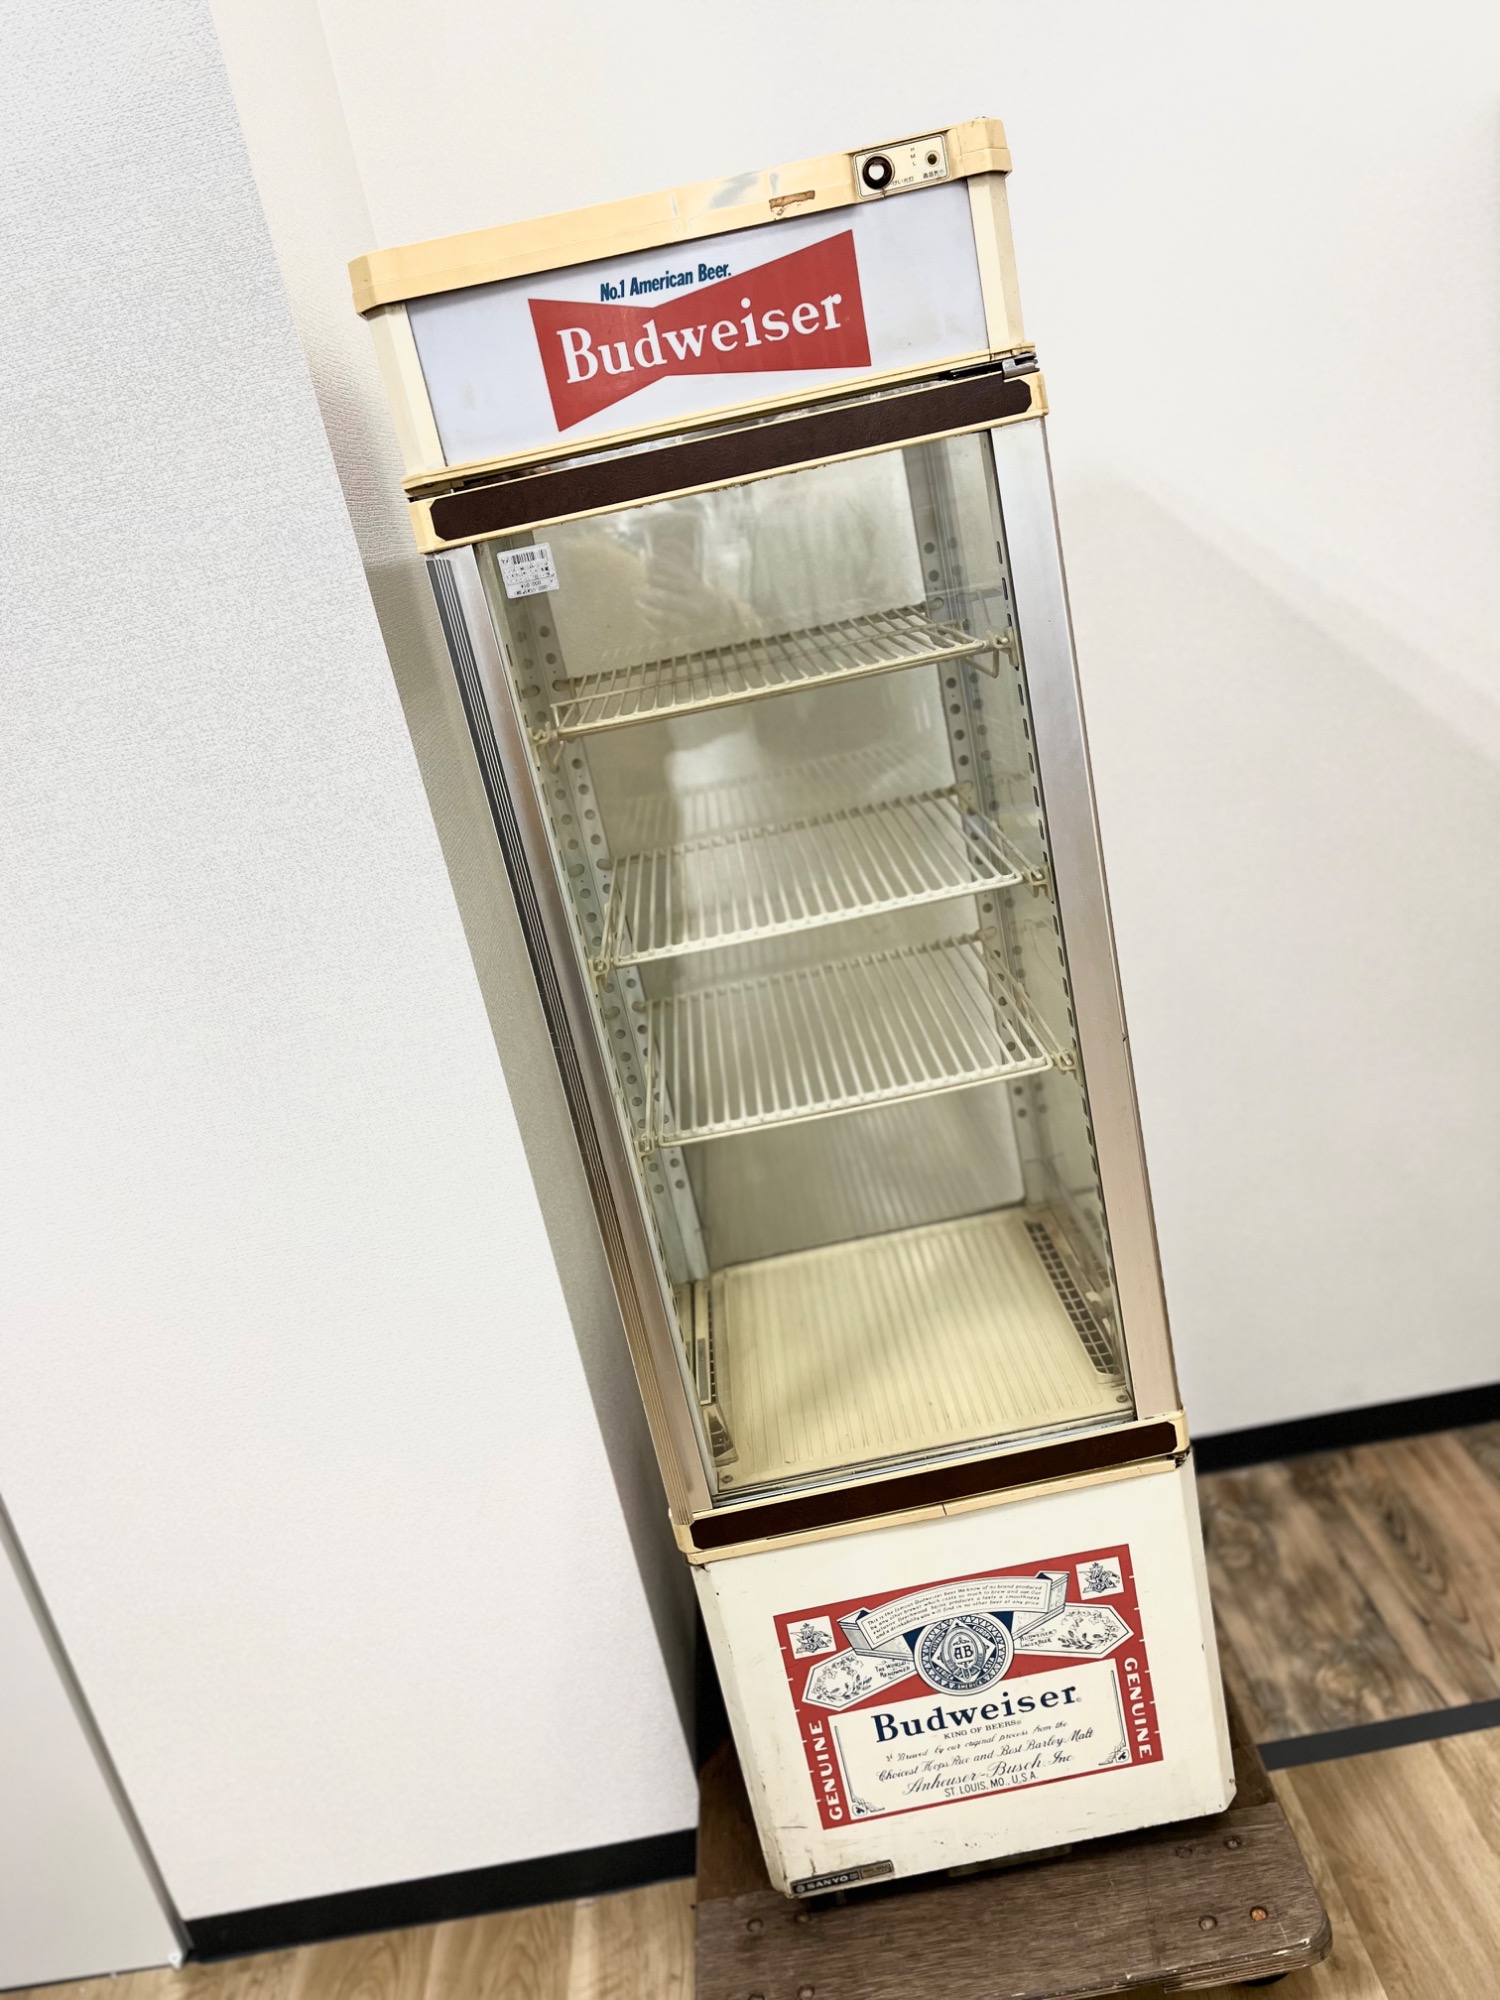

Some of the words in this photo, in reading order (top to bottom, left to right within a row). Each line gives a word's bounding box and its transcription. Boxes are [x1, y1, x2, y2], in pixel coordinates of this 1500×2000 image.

[600, 279, 625, 302] No.1
[629, 270, 694, 296] American
[698, 263, 732, 282] Beer.
[556, 294, 842, 384] Budweiser
[890, 1612, 903, 1620] other
[982, 1658, 995, 1673] ASIA
[870, 1686, 1076, 1743] Budweiser
[1124, 1657, 1152, 1759] GENUINE
[877, 1765, 919, 1783] Choicest
[973, 1750, 994, 1762] and
[997, 1744, 1022, 1757] Best
[1066, 1727, 1093, 1742] Malt
[898, 1749, 928, 1761] Brewed
[934, 1745, 944, 1754] by
[964, 1733, 996, 1748] original
[998, 1731, 1028, 1742] process
[1032, 1724, 1052, 1734] from
[1055, 1720, 1068, 1728] the
[944, 1730, 967, 1740] KING
[808, 1720, 843, 1820] GENUINE
[806, 1875, 848, 1889] SANYO
